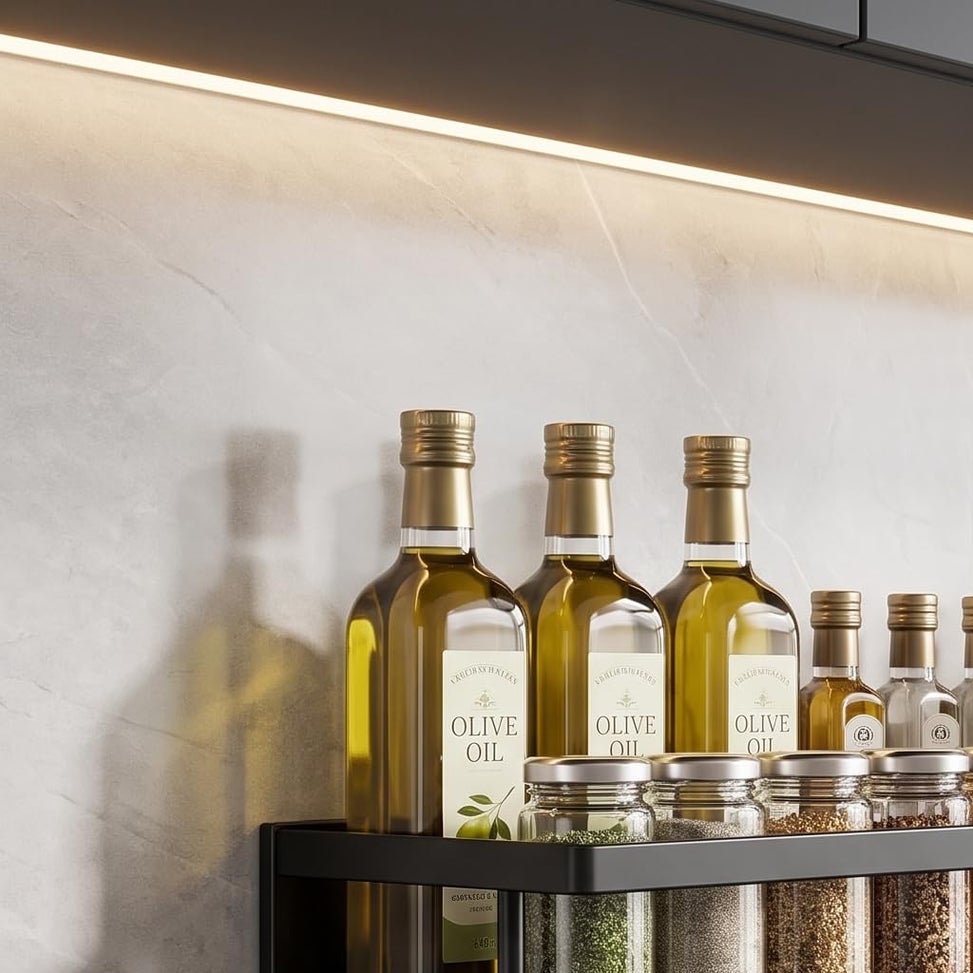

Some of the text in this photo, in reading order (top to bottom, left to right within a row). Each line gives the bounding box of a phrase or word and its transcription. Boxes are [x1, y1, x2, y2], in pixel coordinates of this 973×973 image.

[451, 716, 518, 737] OLIVE
[596, 715, 657, 736] OLIVE
[735, 714, 790, 734] OLIVE
[466, 742, 504, 763] OIL
[609, 740, 644, 757] OIL
